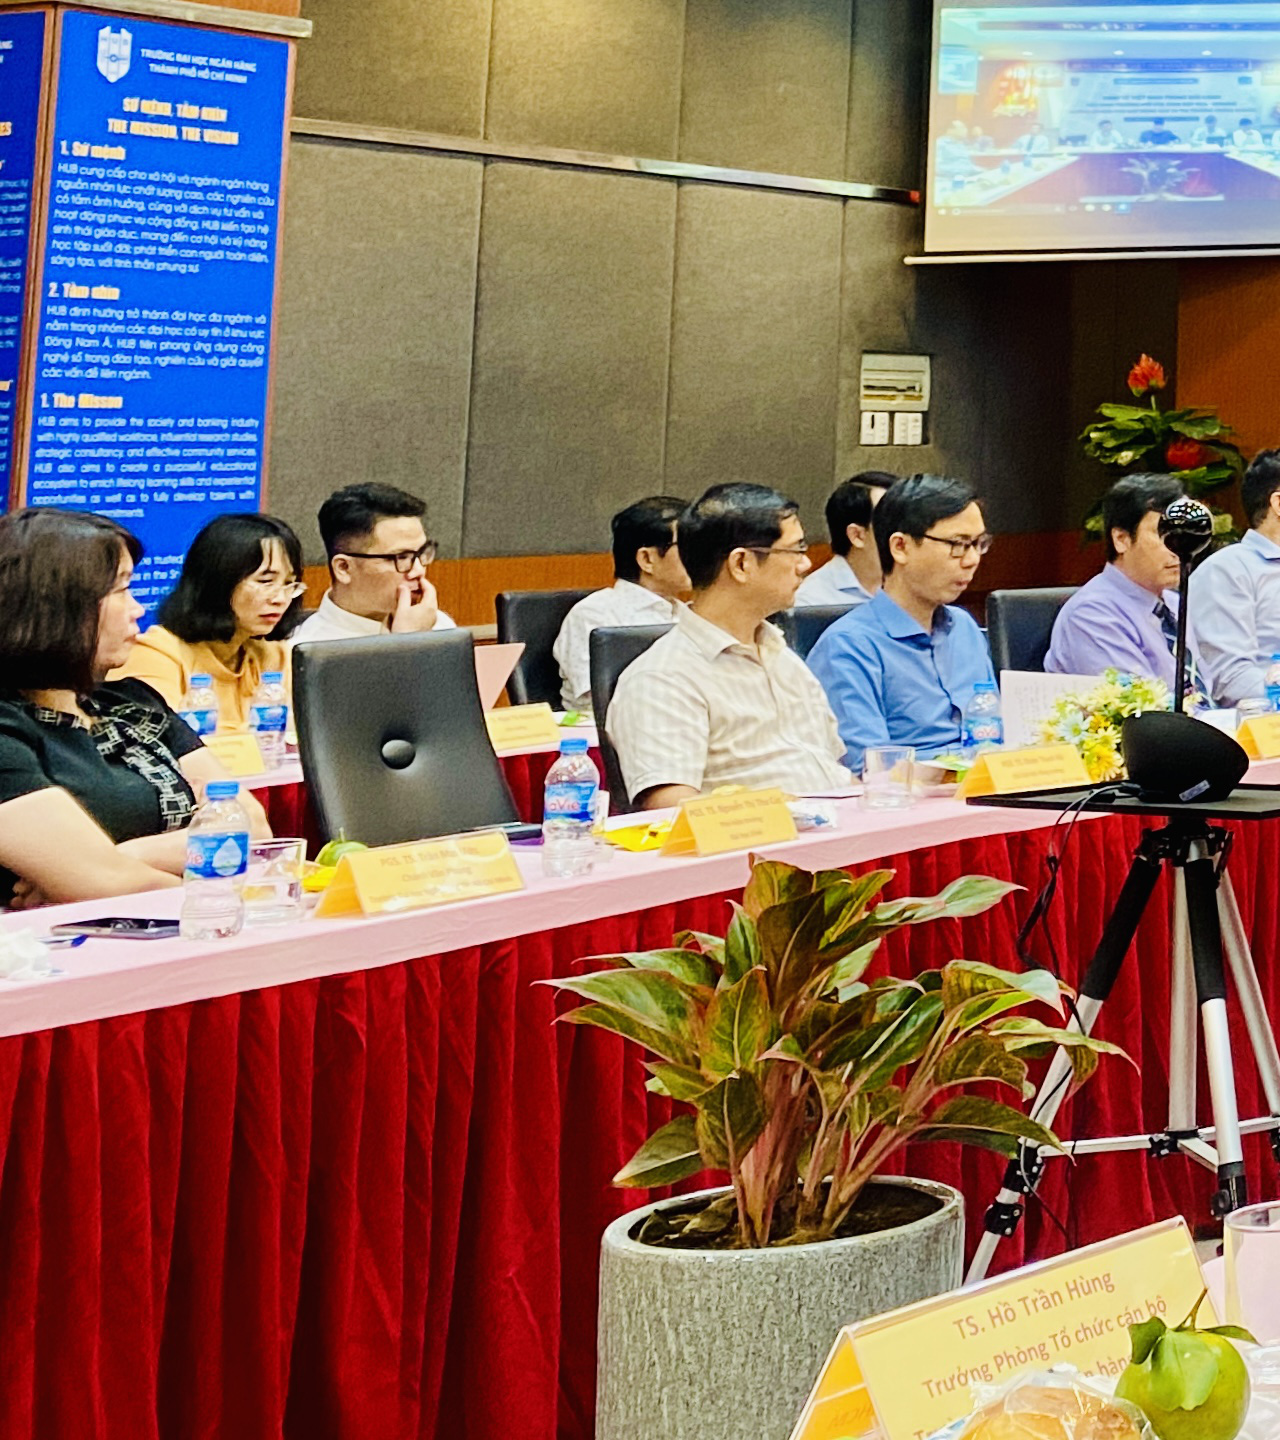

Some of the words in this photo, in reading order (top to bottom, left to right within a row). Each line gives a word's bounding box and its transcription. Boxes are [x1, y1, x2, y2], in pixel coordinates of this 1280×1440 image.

[921, 1355, 994, 1399] Trưởng
[994, 1342, 1051, 1378] Phòng
[1049, 1326, 1072, 1353] Tổ
[1074, 1316, 1115, 1345] chức
[1116, 1305, 1144, 1328] cán
[1145, 1294, 1167, 1318] bộ
[953, 1316, 986, 1340] TS.
[989, 1297, 1017, 1329] Hồ
[1018, 1285, 1064, 1320] Trần
[1065, 1271, 1115, 1309] Hùng
